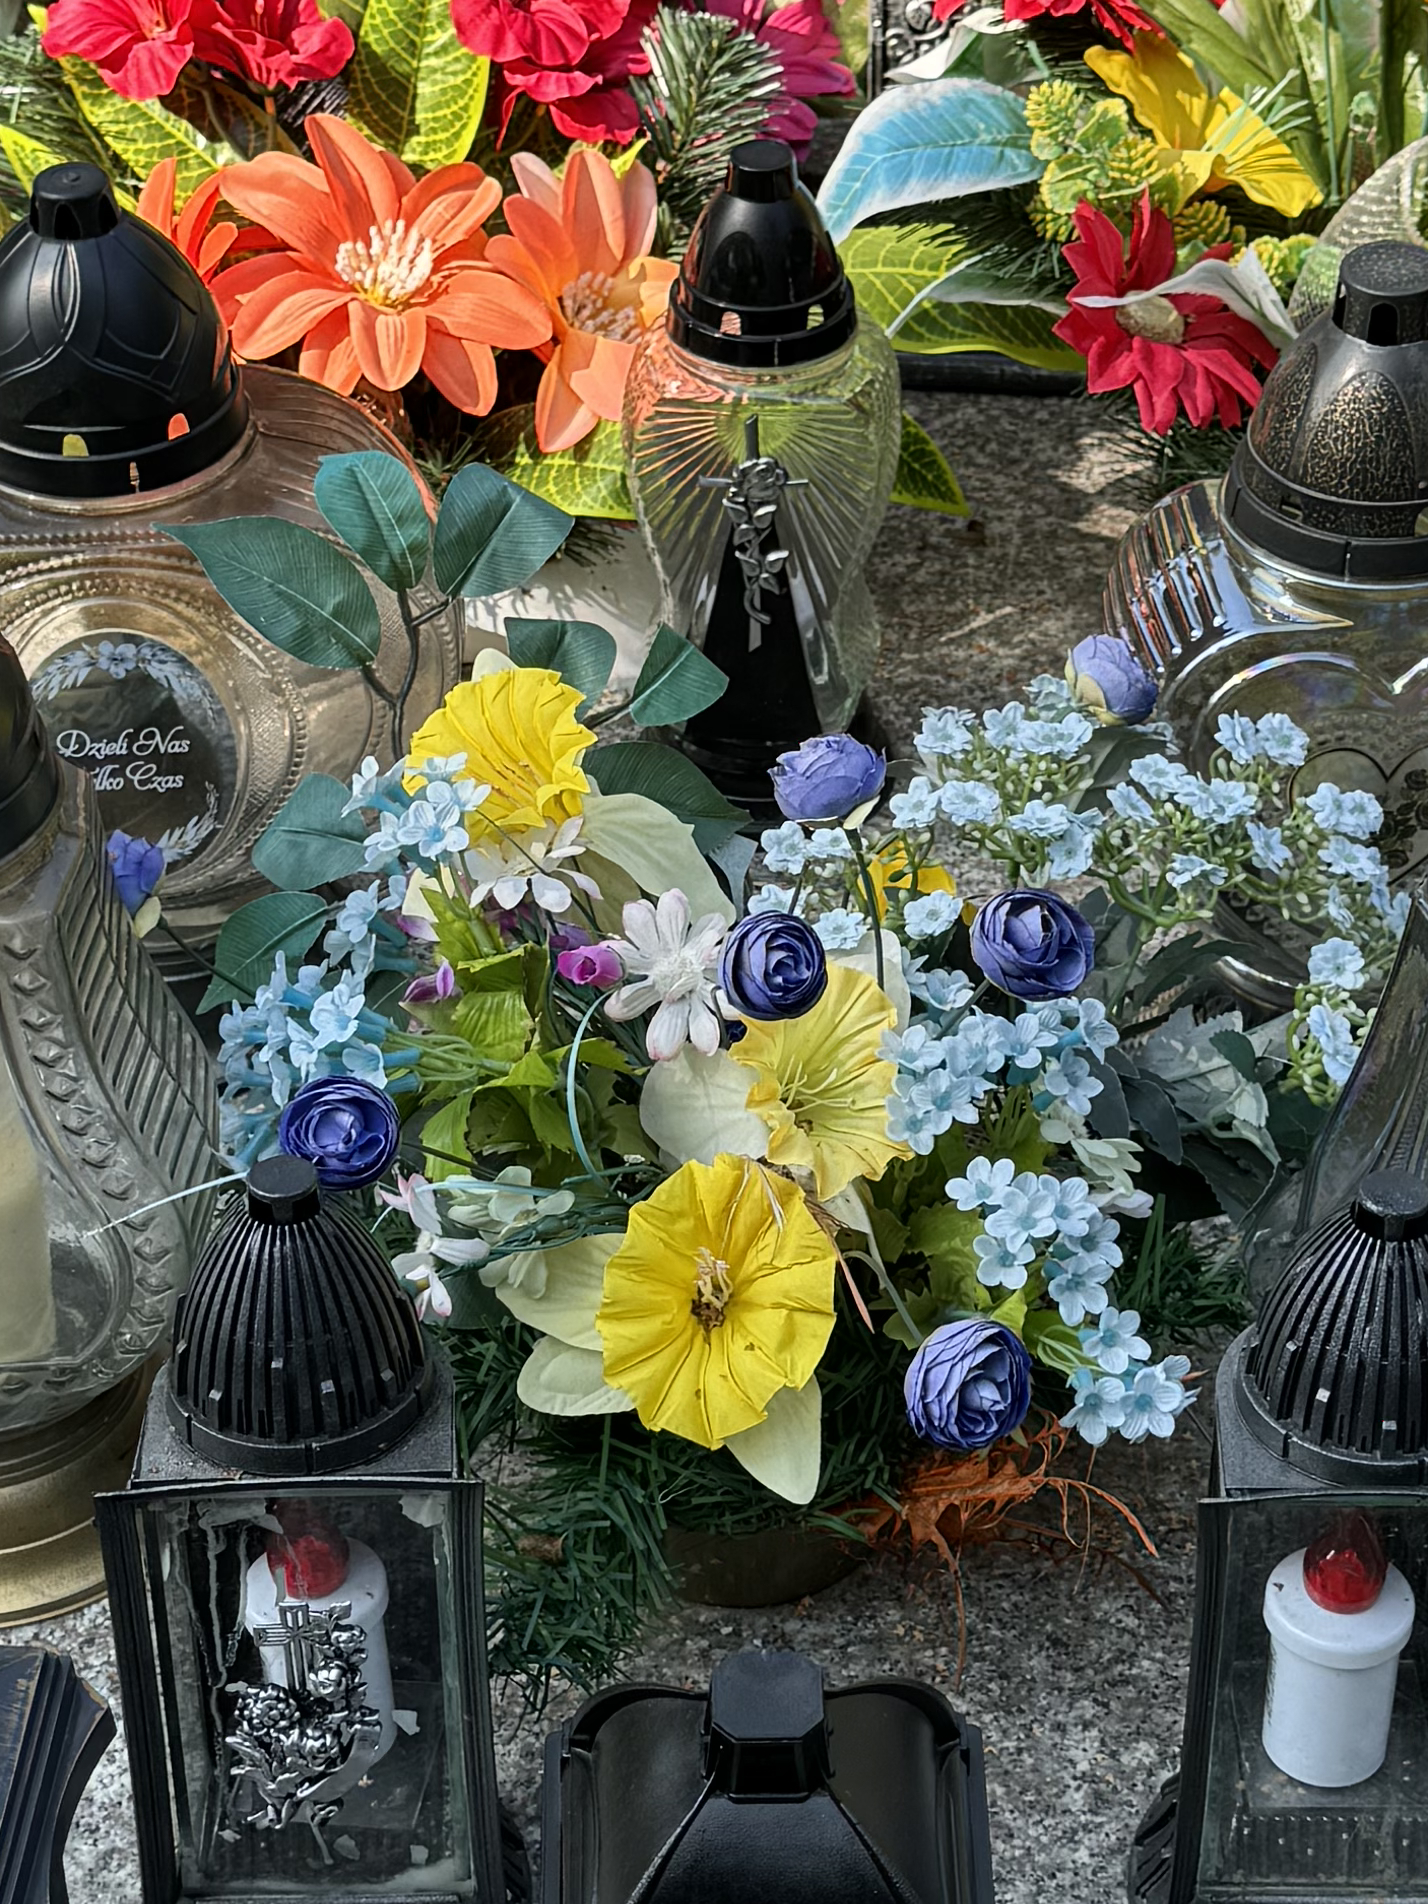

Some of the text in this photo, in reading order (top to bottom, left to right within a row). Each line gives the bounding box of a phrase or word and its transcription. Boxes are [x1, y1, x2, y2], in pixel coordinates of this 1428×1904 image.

[55, 725, 191, 759] Dzieli Nas
[90, 760, 185, 793] lko Czas
